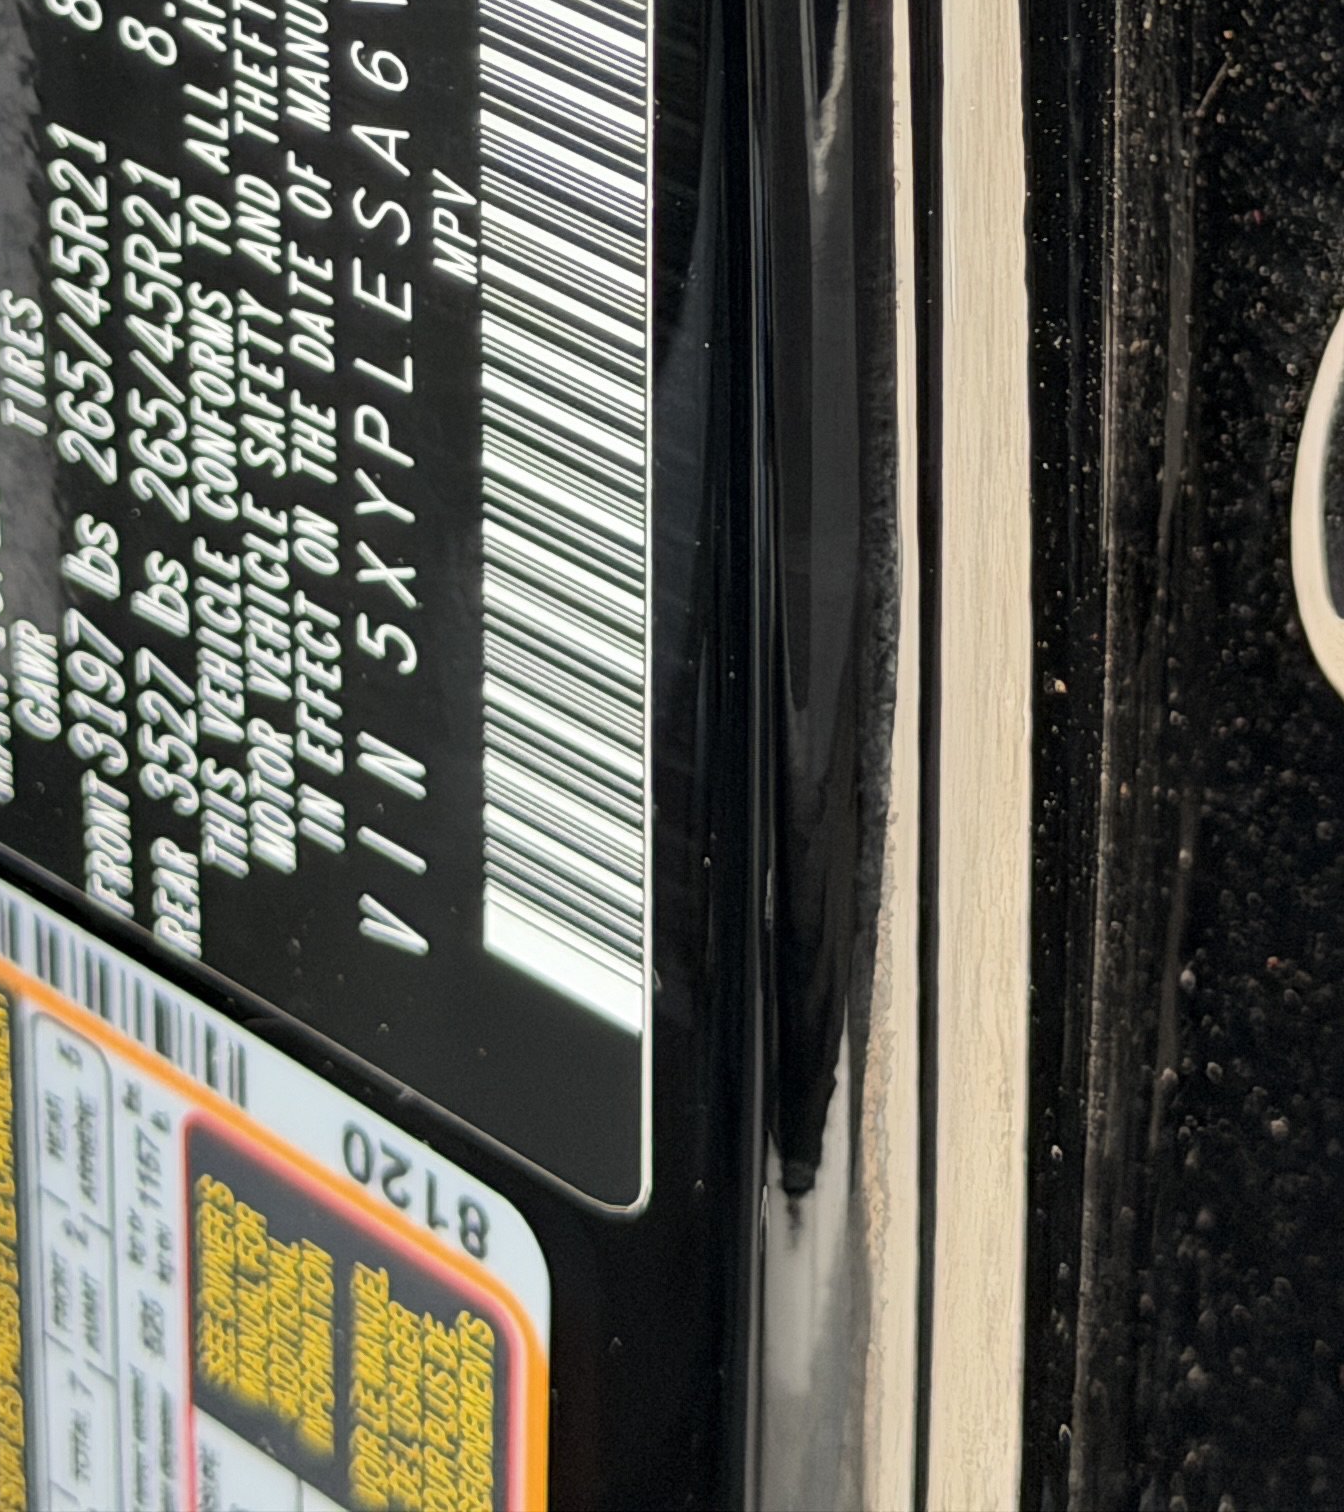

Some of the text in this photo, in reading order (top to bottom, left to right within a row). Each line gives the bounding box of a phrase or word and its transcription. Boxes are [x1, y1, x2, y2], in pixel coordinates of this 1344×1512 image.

[183, 83, 231, 174] ALL
[286, 150, 333, 219] OF
[186, 194, 232, 255] TO
[235, 174, 283, 274] AND
[432, 167, 477, 284] MPV
[46, 121, 117, 484] 265/45R21
[121, 159, 191, 522] 265/45R21
[288, 241, 336, 372] DATE
[187, 282, 239, 521] CONFORMS
[237, 289, 287, 477] SAFETY
[289, 389, 338, 484] THE
[61, 513, 122, 599] lbs
[130, 549, 191, 638] lbs
[241, 492, 293, 700] VEHICLE
[291, 505, 340, 575] ON
[11, 619, 62, 741] GAWR
[64, 608, 129, 775] 3197
[193, 536, 244, 743] VEHICLE
[293, 589, 344, 775] EFFECT
[135, 647, 199, 814] 3527
[247, 717, 296, 873] MOTOR
[80, 769, 135, 919] FRONT
[200, 758, 249, 878] THIS
[296, 784, 346, 852] IN
[356, 731, 430, 956] VIN
[151, 836, 202, 961] REAR
[342, 1122, 489, 1261] 8120
[198, 1314, 235, 1383] SEE
[235, 1201, 268, 1400] MANUAL FOR
[267, 1237, 299, 1419] ADDITIONAL
[297, 1238, 335, 1450] INFORMATION
[350, 1261, 390, 1508] VOIR LE MANUEL
[422, 1312, 458, 1512] OUR PLUS DE
[456, 1311, 494, 1512] SEIGNEMENTS
[388, 1451, 422, 1510] DE
